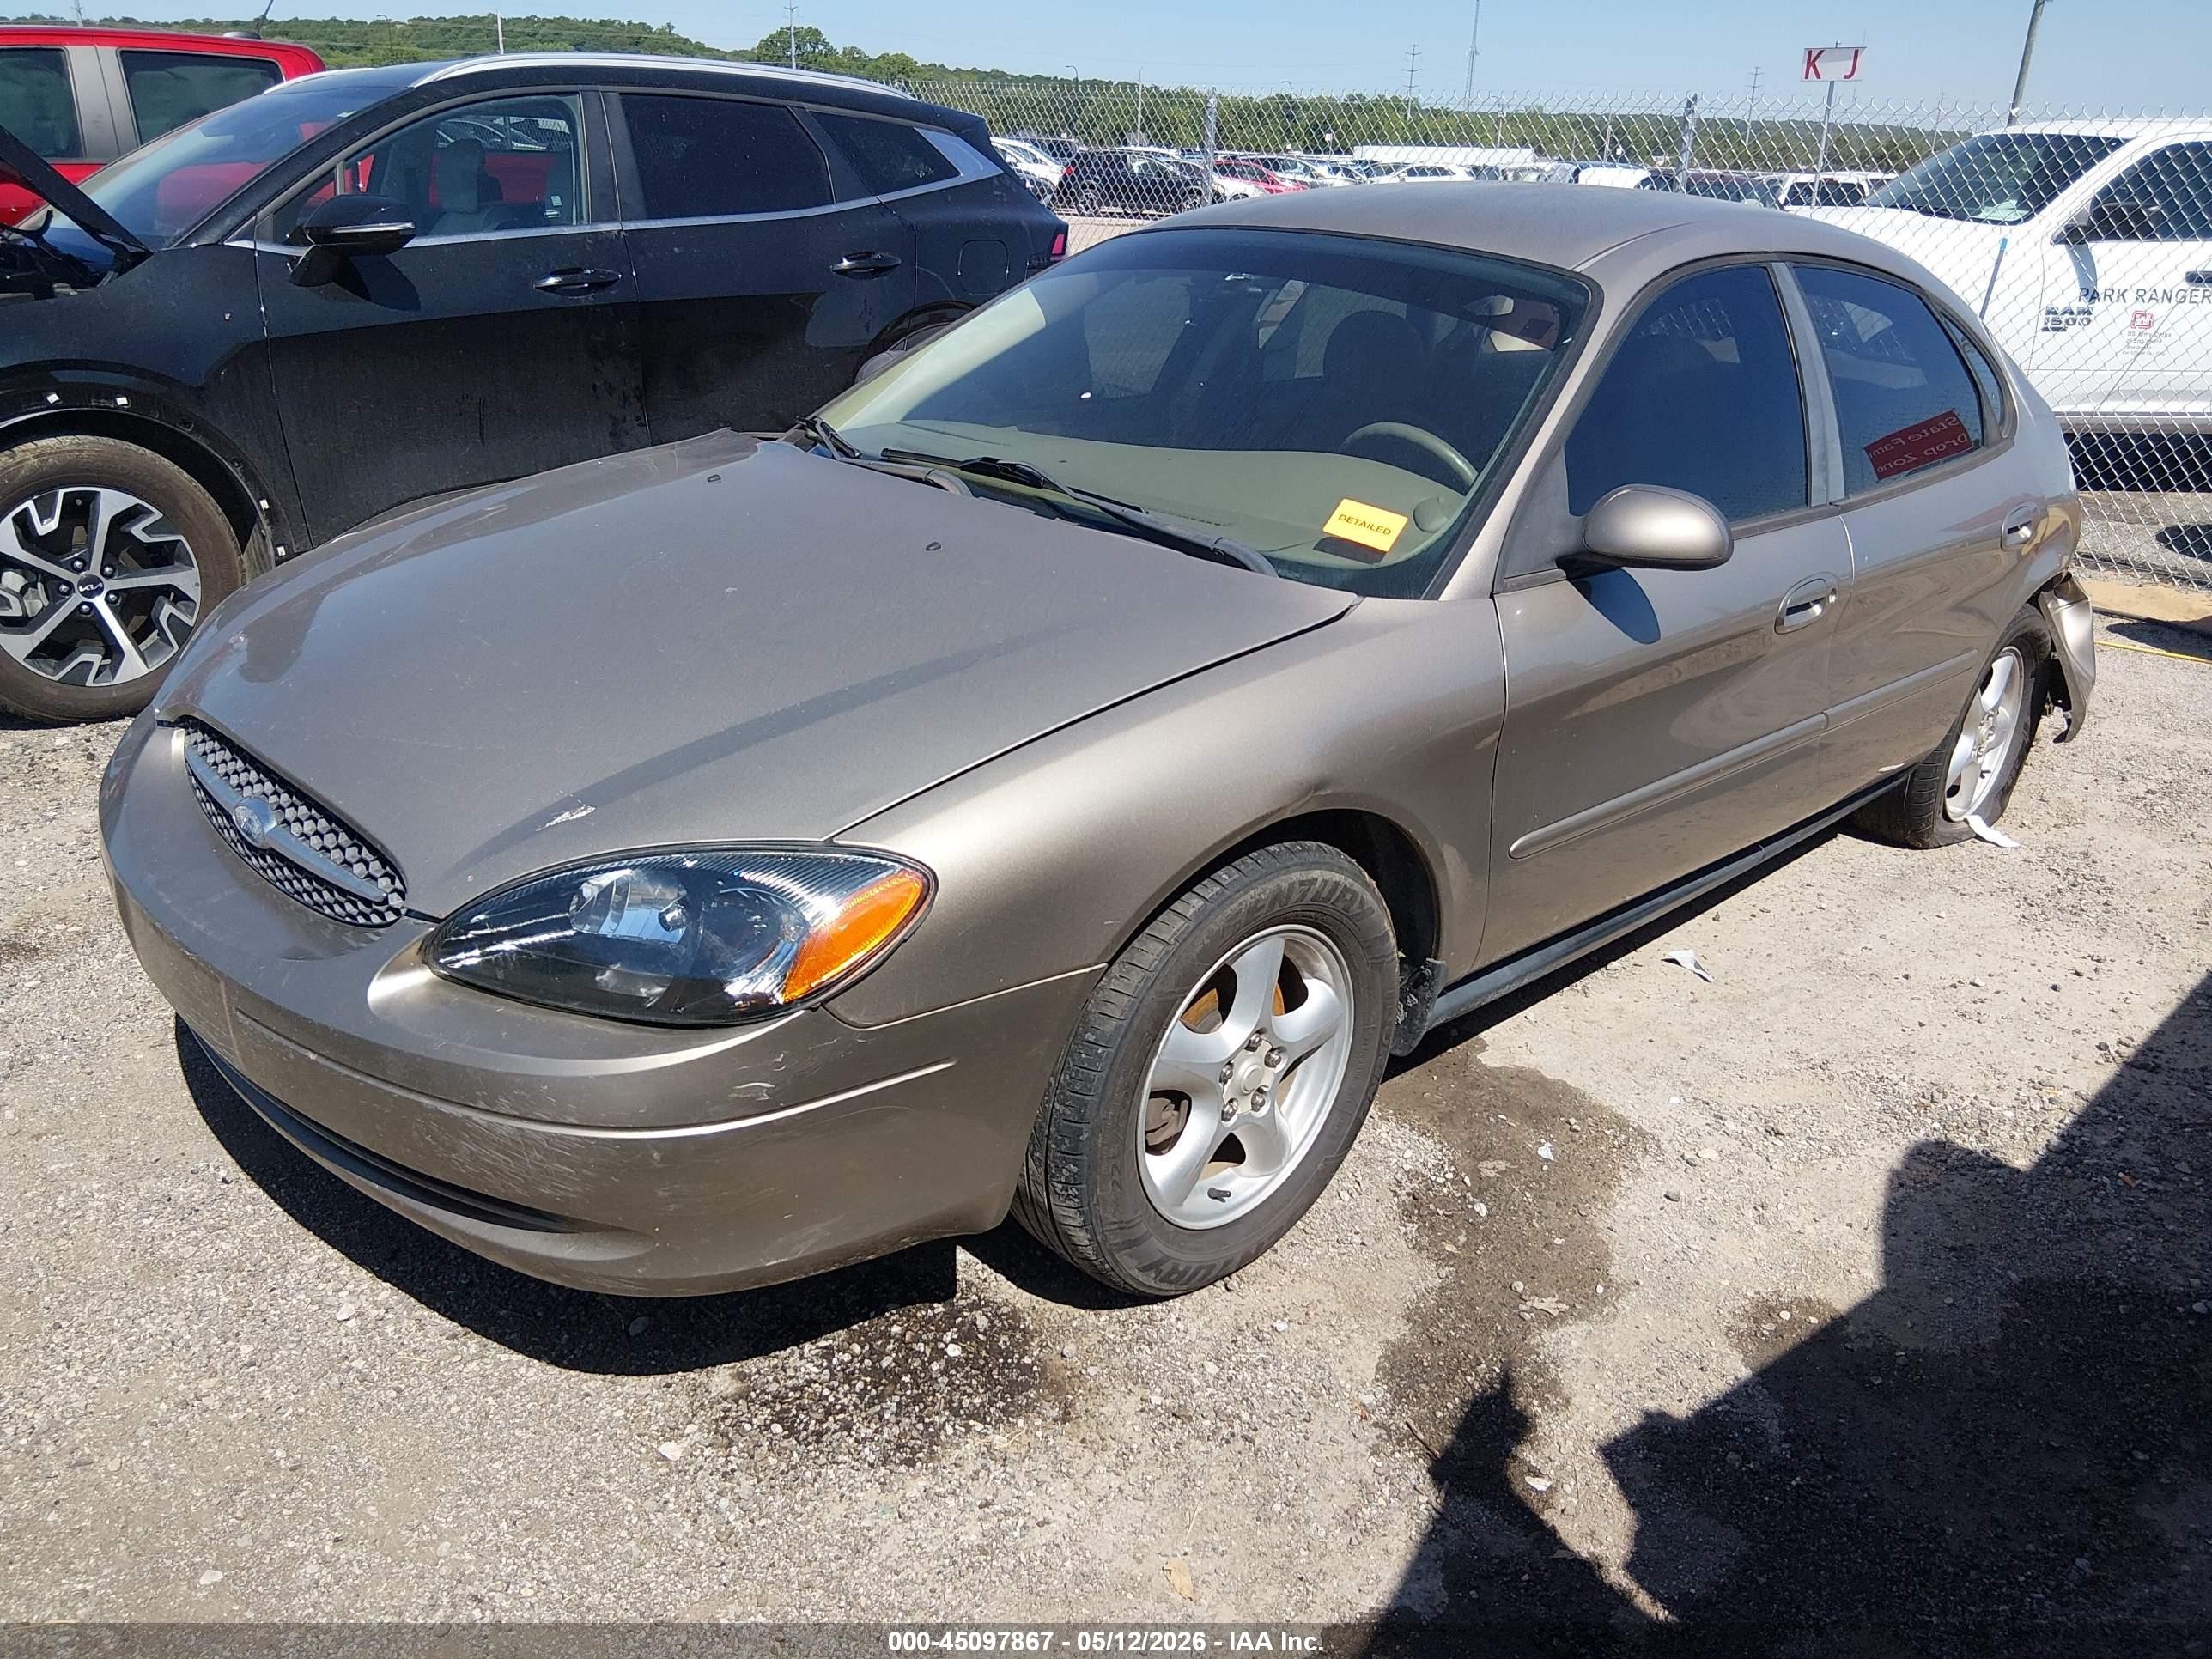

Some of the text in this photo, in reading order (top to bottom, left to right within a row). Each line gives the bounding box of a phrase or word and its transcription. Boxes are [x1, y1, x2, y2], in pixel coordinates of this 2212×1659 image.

[1805, 49, 1859, 80] K J
[2078, 287, 2212, 304] PARK RANGER
[1338, 514, 1392, 536] DETAILED
